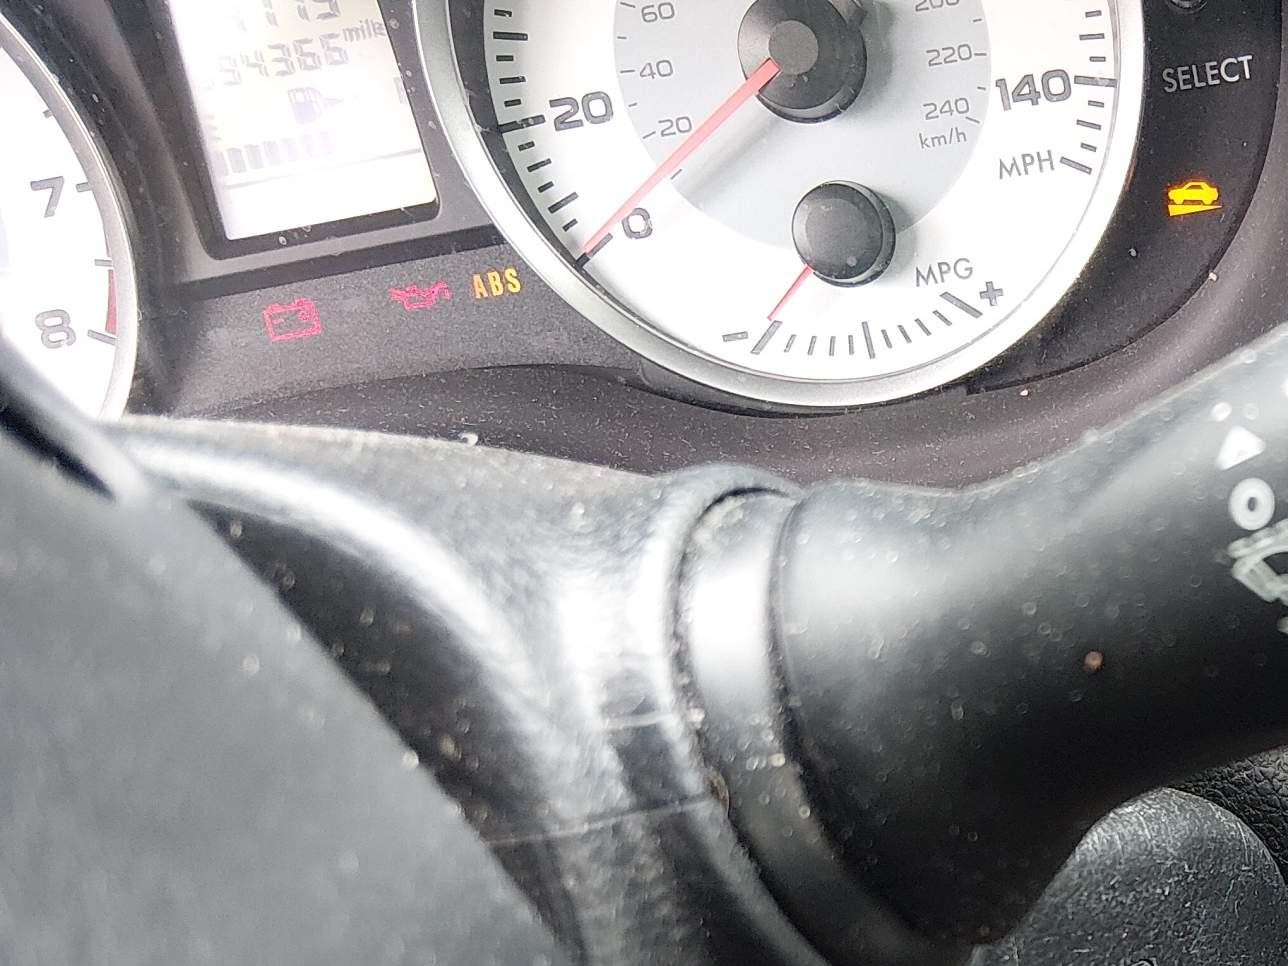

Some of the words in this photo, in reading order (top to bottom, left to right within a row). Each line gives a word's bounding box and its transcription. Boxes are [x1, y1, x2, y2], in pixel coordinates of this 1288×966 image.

[641, 2, 676, 23] 60
[639, 59, 674, 79] 40
[926, 43, 973, 67] 220
[1162, 55, 1253, 93] SELECT
[995, 69, 1072, 111] 140
[549, 91, 614, 131] 20
[923, 97, 970, 121] 240
[658, 116, 693, 137] 20
[919, 127, 968, 149] km/h
[1000, 150, 1056, 180] MPH
[30, 176, 64, 218] 7
[622, 207, 653, 239] 0
[472, 267, 522, 299] ABS
[915, 257, 974, 288] MPG
[35, 309, 77, 349] 8
